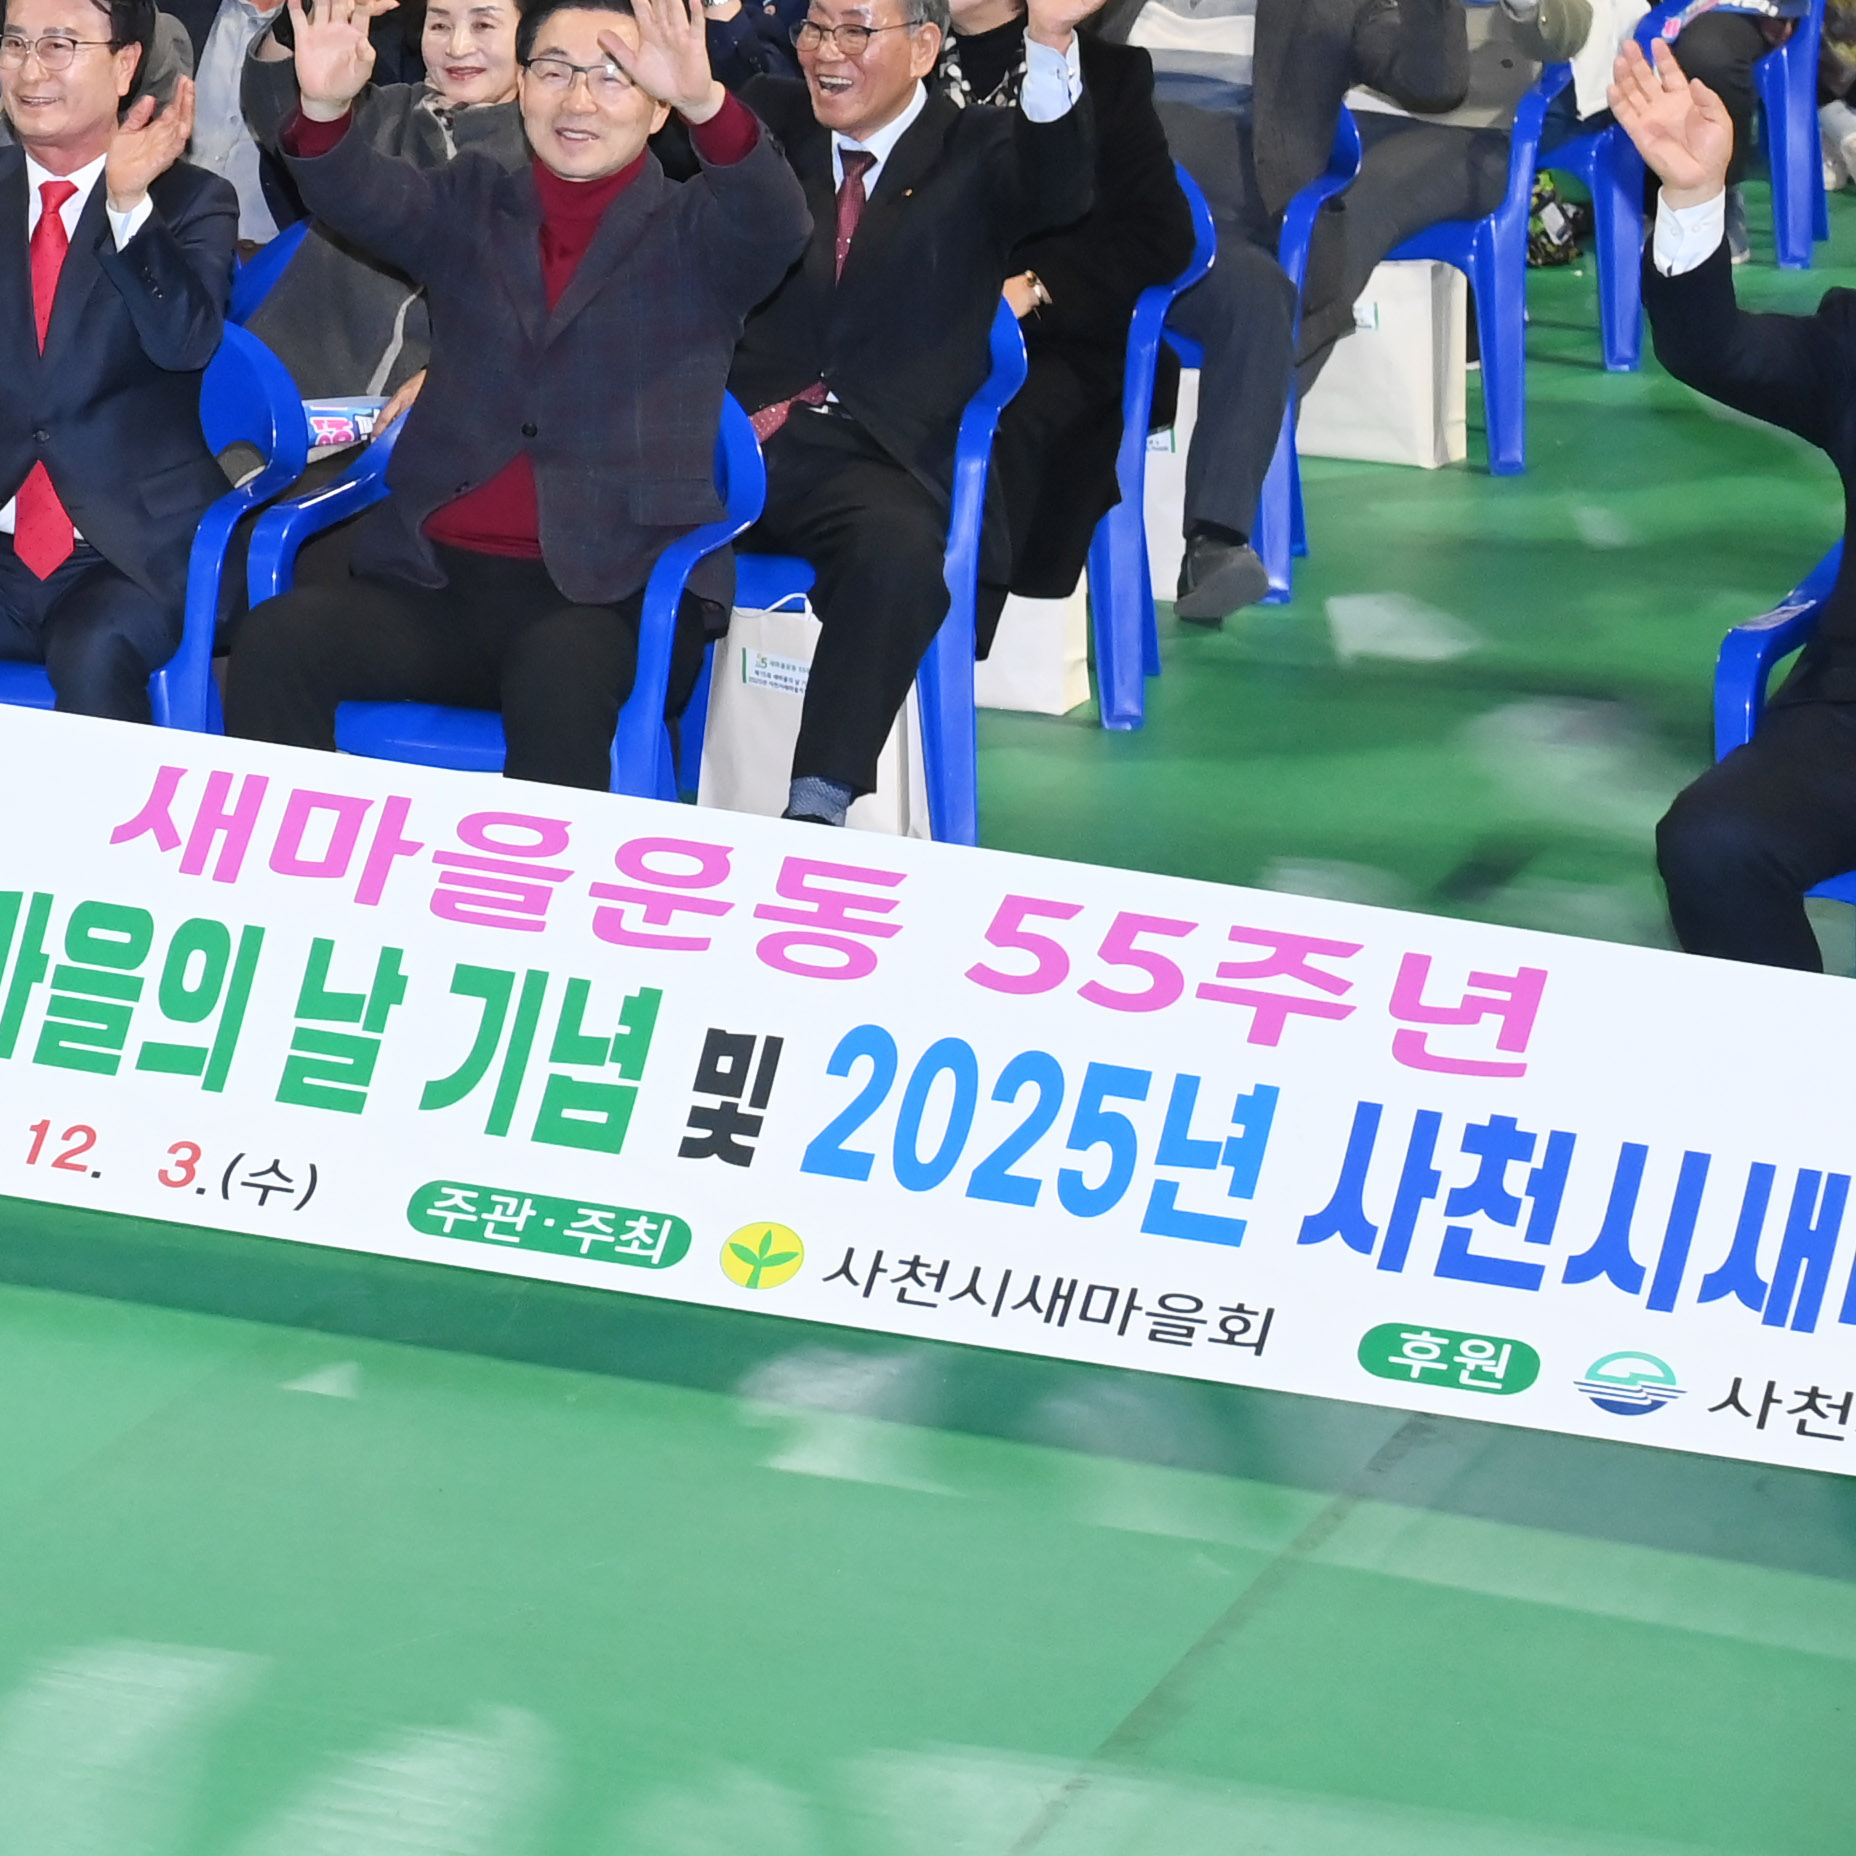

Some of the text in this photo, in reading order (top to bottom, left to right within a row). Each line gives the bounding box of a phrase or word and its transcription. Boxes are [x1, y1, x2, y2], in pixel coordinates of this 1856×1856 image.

[109, 765, 1550, 1080] 새마을운동 55주년
[23, 1117, 103, 1181] 12.
[274, 937, 408, 1116] 날
[418, 960, 664, 1156] 기념
[677, 1026, 785, 1170] 및
[797, 1022, 1282, 1249] 2025년
[822, 1243, 1278, 1360] 사천시새마을회
[1386, 1330, 1513, 1389] 후원
[1707, 1376, 1856, 1443] 사천
